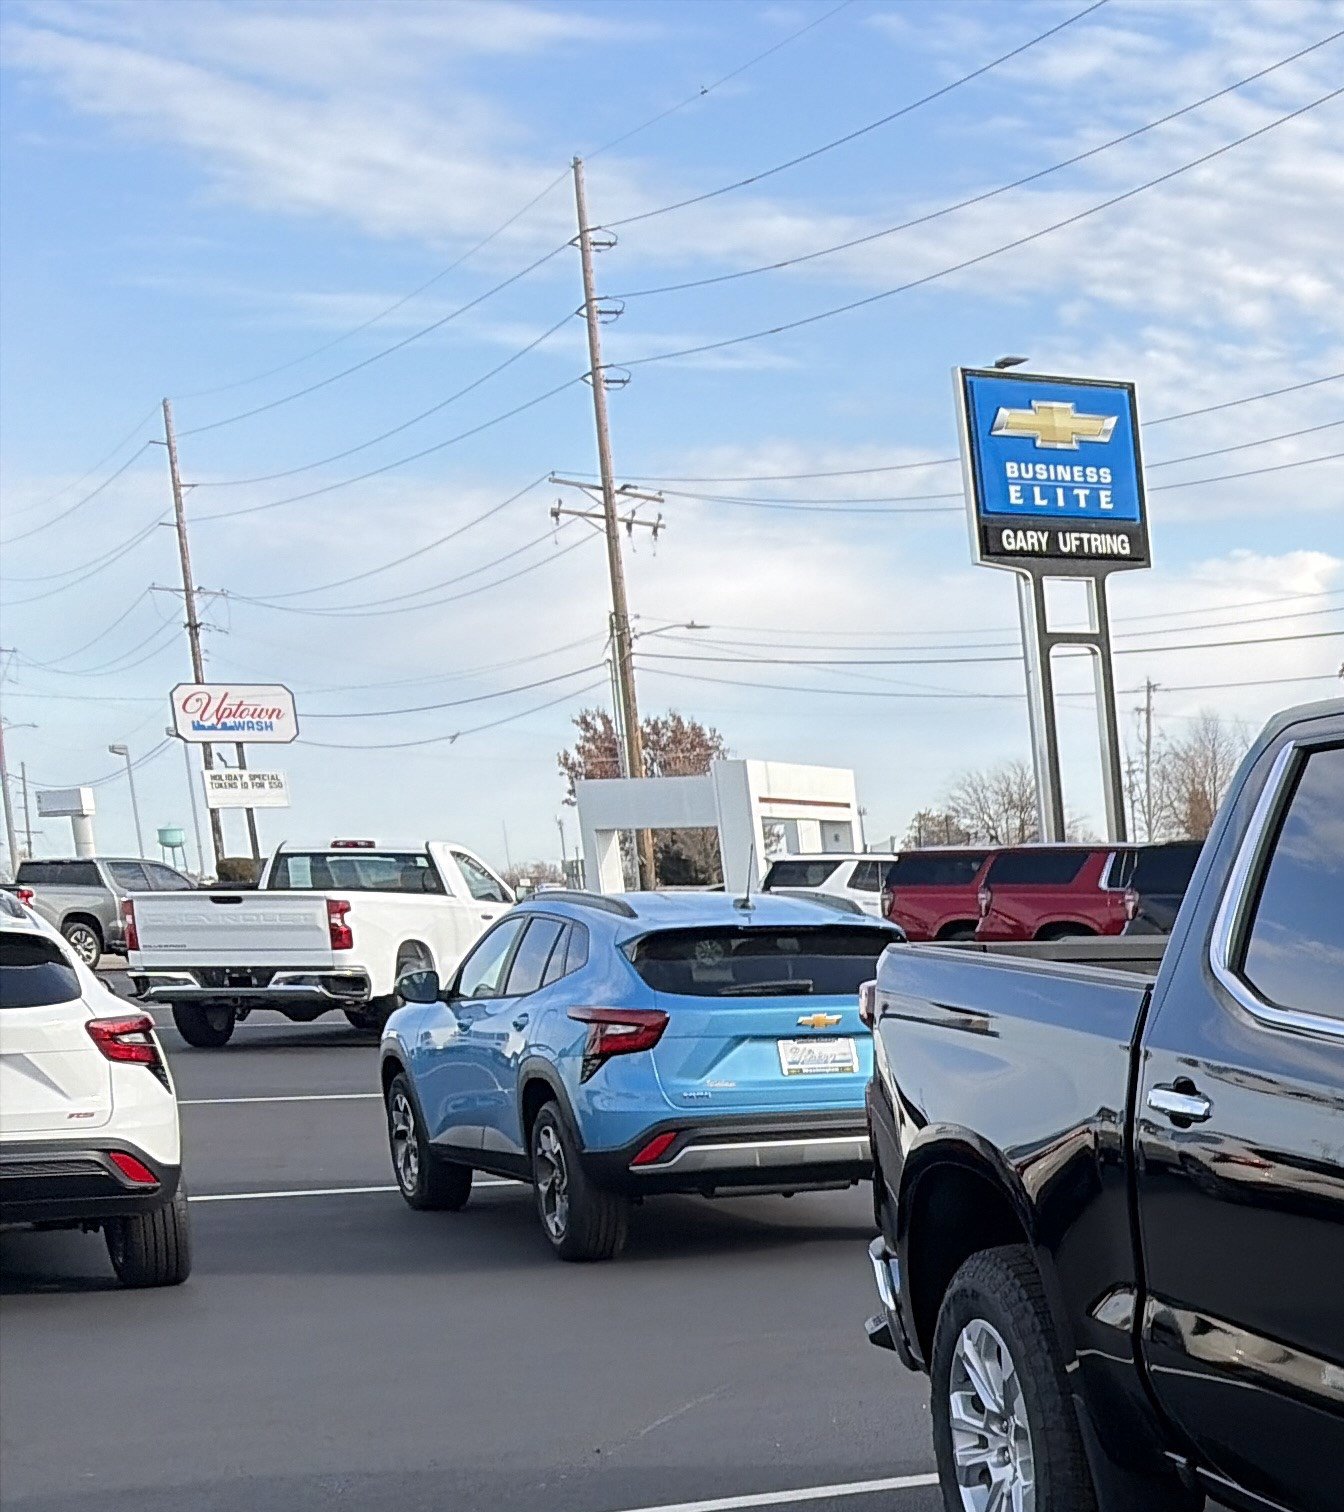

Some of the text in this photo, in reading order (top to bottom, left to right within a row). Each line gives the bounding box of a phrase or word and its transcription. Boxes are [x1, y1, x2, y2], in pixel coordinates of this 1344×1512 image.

[1005, 461, 1112, 484] BUSINESS
[1008, 485, 1114, 510] ELITE
[1002, 529, 1131, 555] GARY UFTRING
[182, 691, 286, 726] Uptown
[234, 720, 274, 731] WASH
[210, 773, 281, 781] HOLIDAY SPECIAL
[251, 781, 266, 789] FOR
